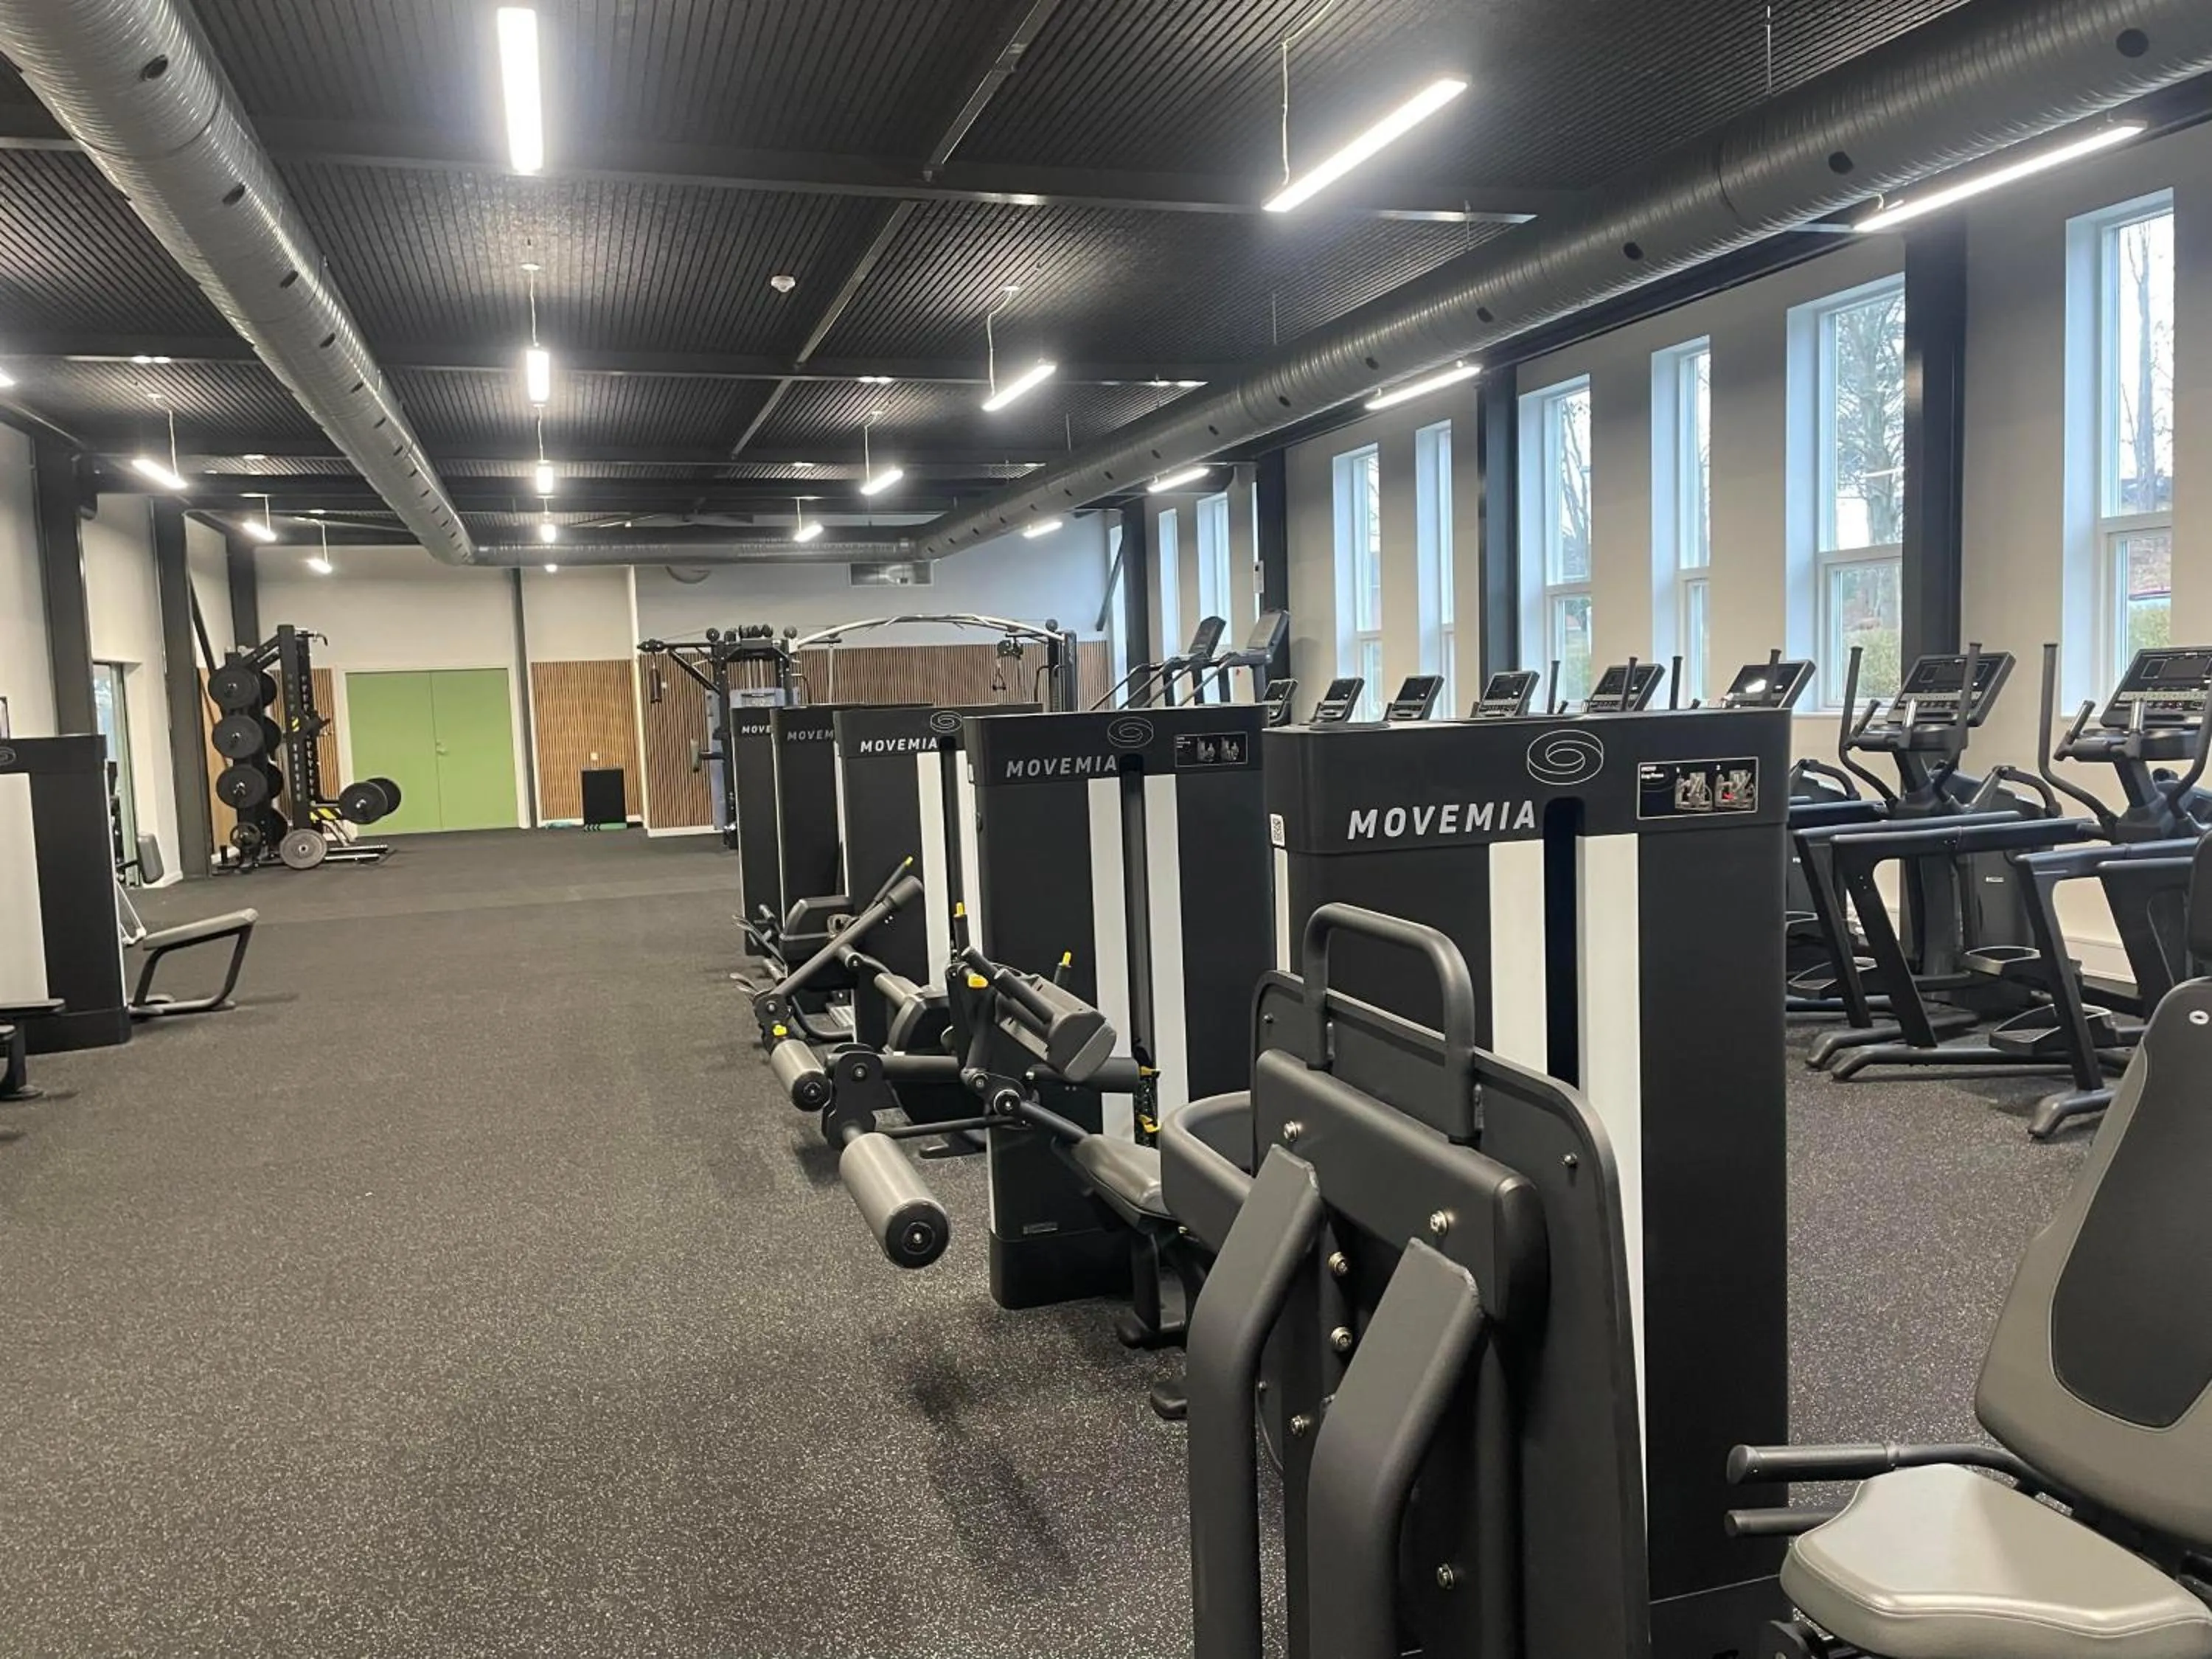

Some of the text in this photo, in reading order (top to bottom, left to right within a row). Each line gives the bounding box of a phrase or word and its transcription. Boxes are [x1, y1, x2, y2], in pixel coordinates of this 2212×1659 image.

[787, 730, 834, 740] MOVEM
[860, 737, 938, 753] MOVEMIA
[1006, 754, 1117, 778] MOVEMIA
[1347, 800, 1535, 840] MOVEMIA
